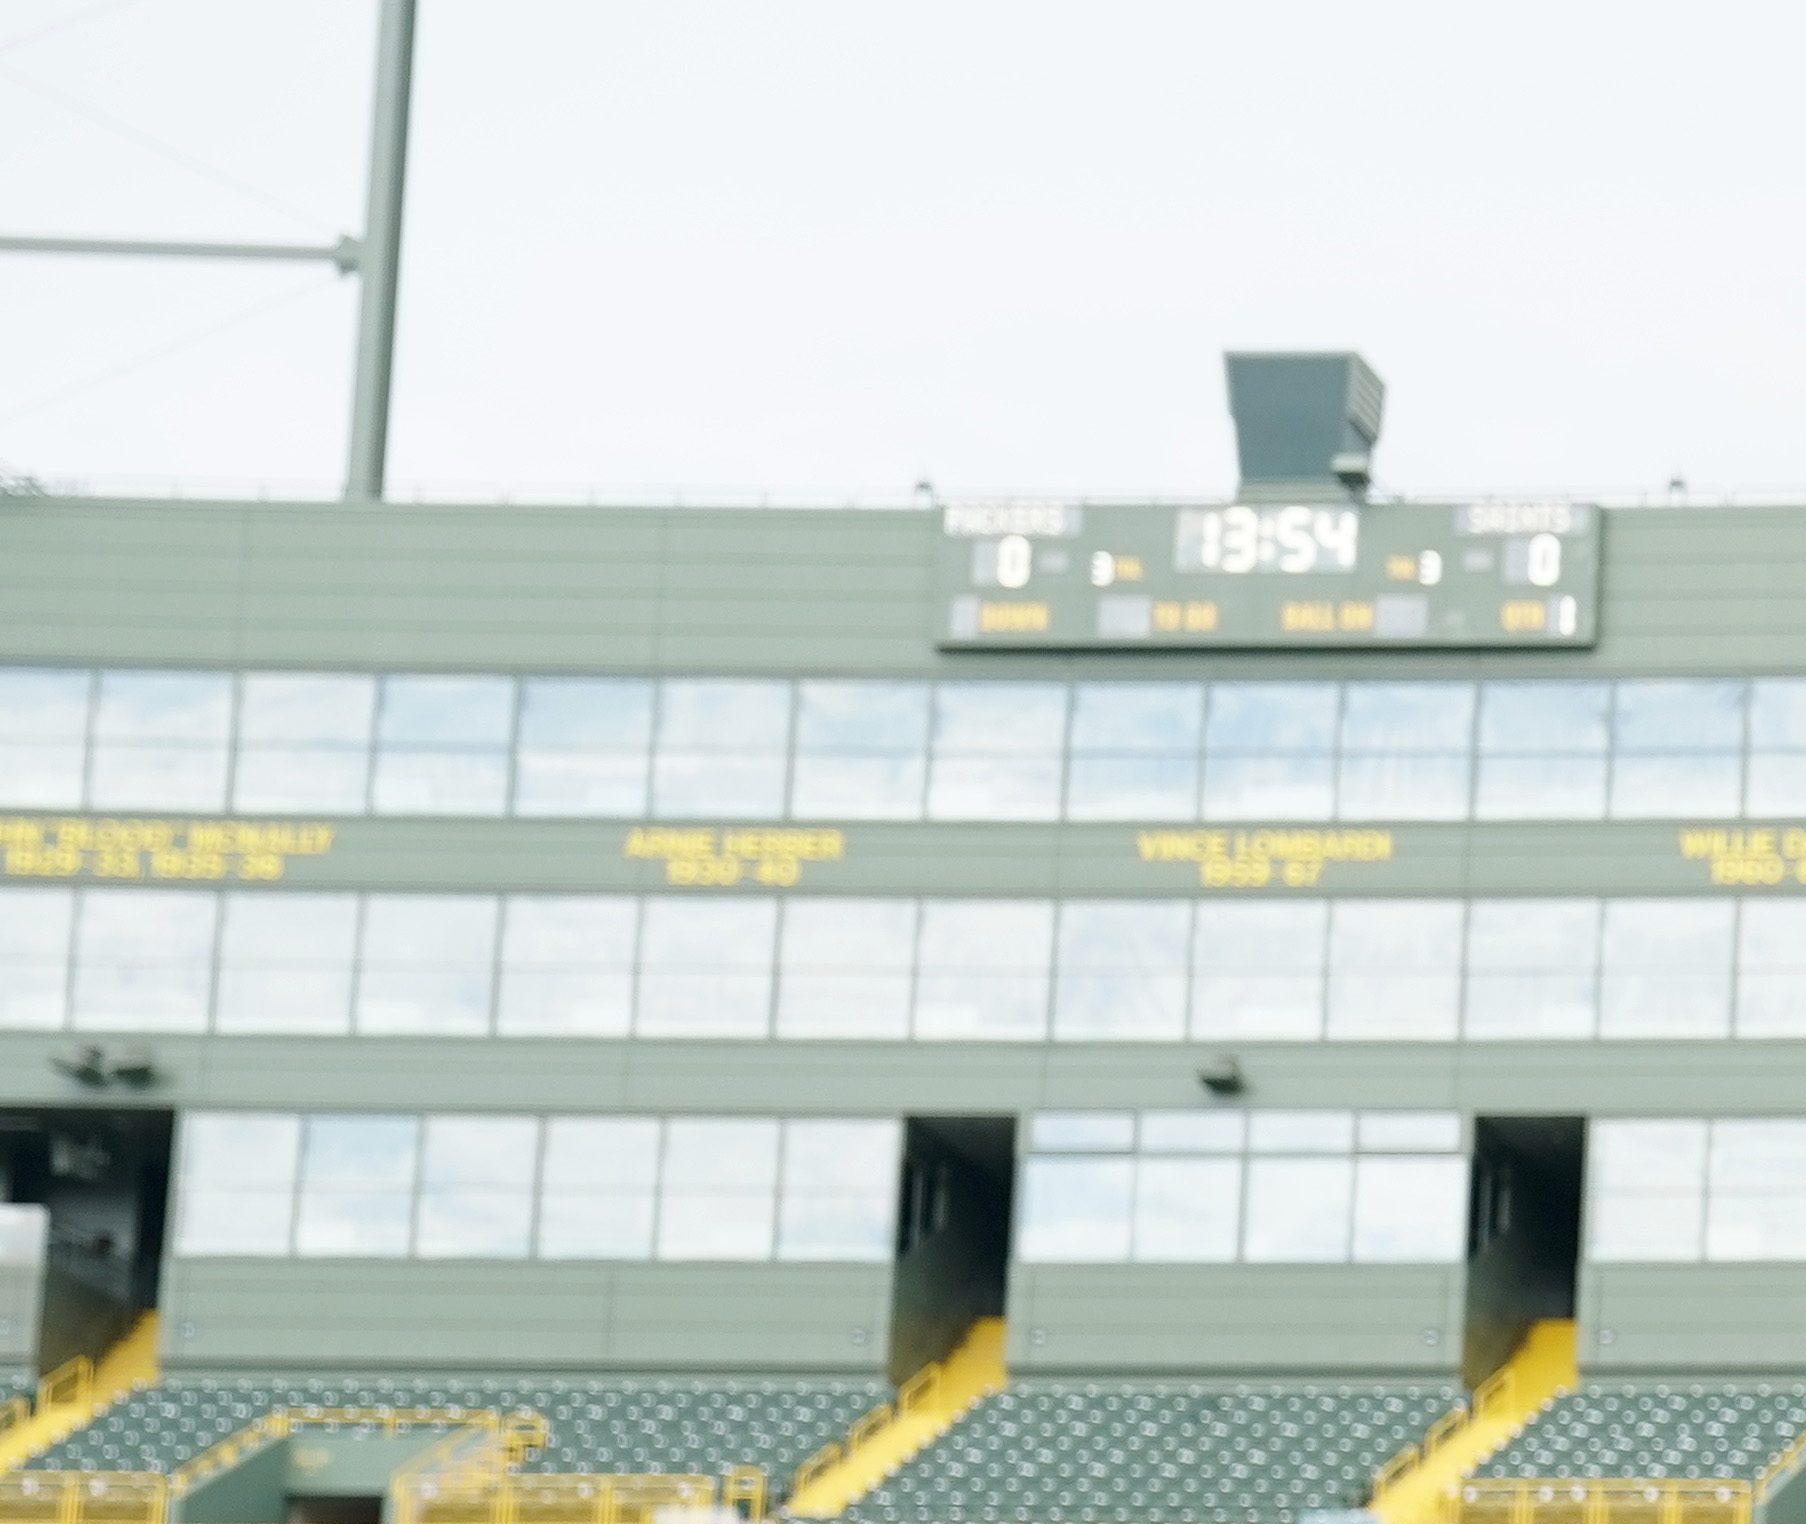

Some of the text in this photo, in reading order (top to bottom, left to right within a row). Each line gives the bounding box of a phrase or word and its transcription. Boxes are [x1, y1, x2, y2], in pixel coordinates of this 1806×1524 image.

[998, 534, 1031, 588] 0
[1201, 506, 1358, 573] 13:54
[1528, 532, 1561, 586] 0
[1559, 595, 1577, 636] 1
[1680, 828, 1777, 859] WILLIE
